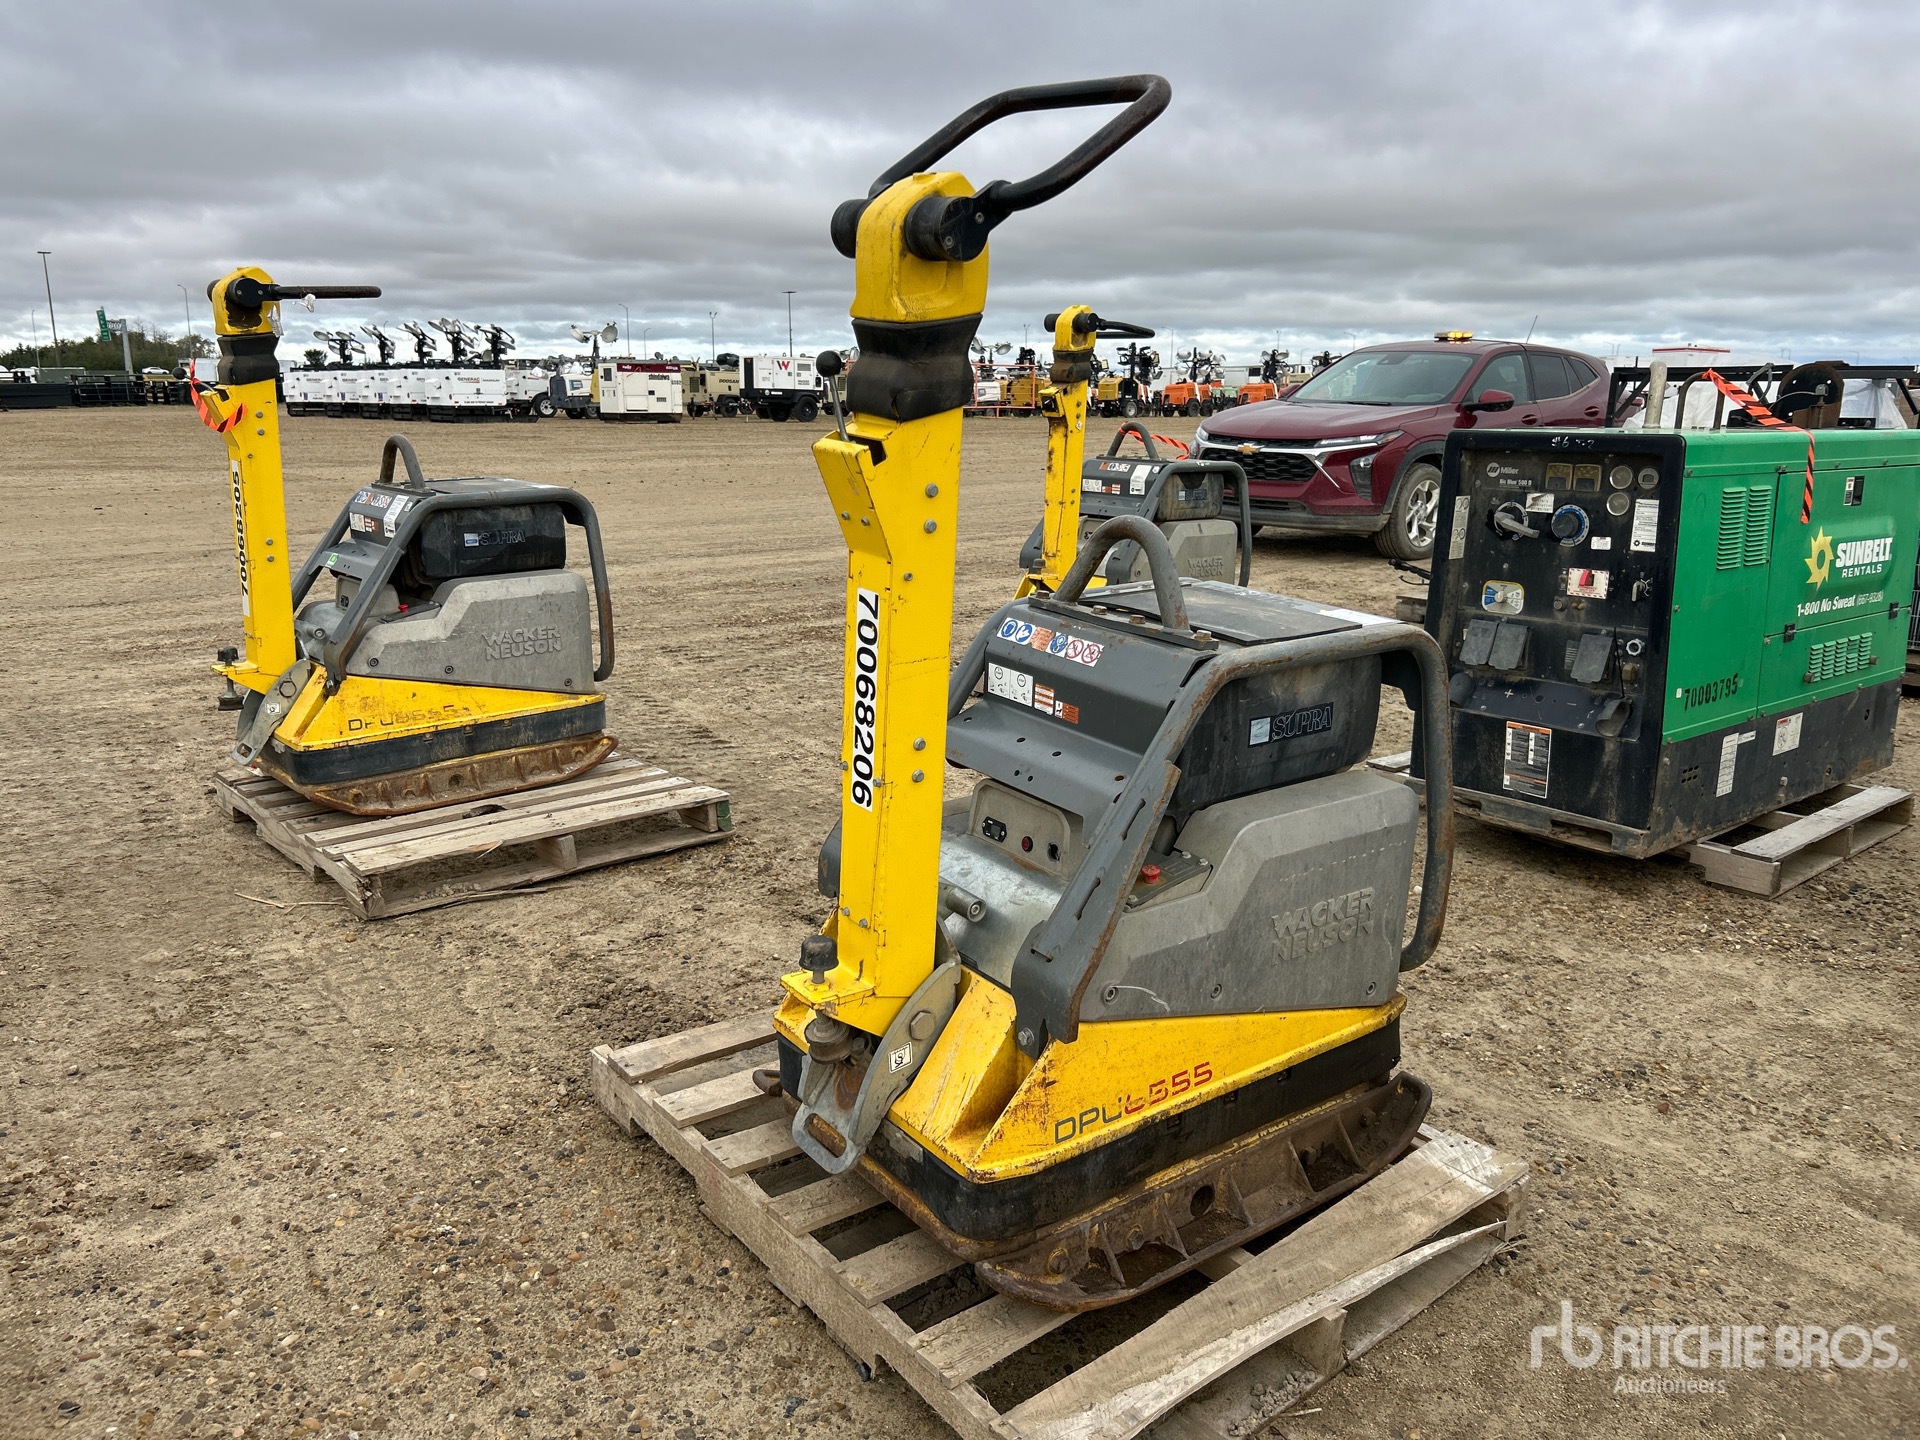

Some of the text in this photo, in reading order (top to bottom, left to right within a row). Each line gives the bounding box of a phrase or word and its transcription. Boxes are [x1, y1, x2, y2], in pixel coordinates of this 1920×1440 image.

[1501, 466, 1519, 474] Miller
[232, 471, 249, 597] 70068205
[1836, 537, 1893, 568] SUNBELT
[1842, 563, 1883, 579] RENTALS
[1797, 601, 1820, 617] 1-800
[1820, 598, 1832, 612] No
[1832, 594, 1856, 611] Sweat
[482, 625, 562, 647] WACKER
[485, 638, 562, 661] NEUSON
[852, 594, 879, 807] 70068206
[1684, 672, 1739, 712] 70003795
[1271, 706, 1332, 742] SUPRA
[1271, 886, 1376, 939] WACKER
[1271, 914, 1375, 966] NEUSON
